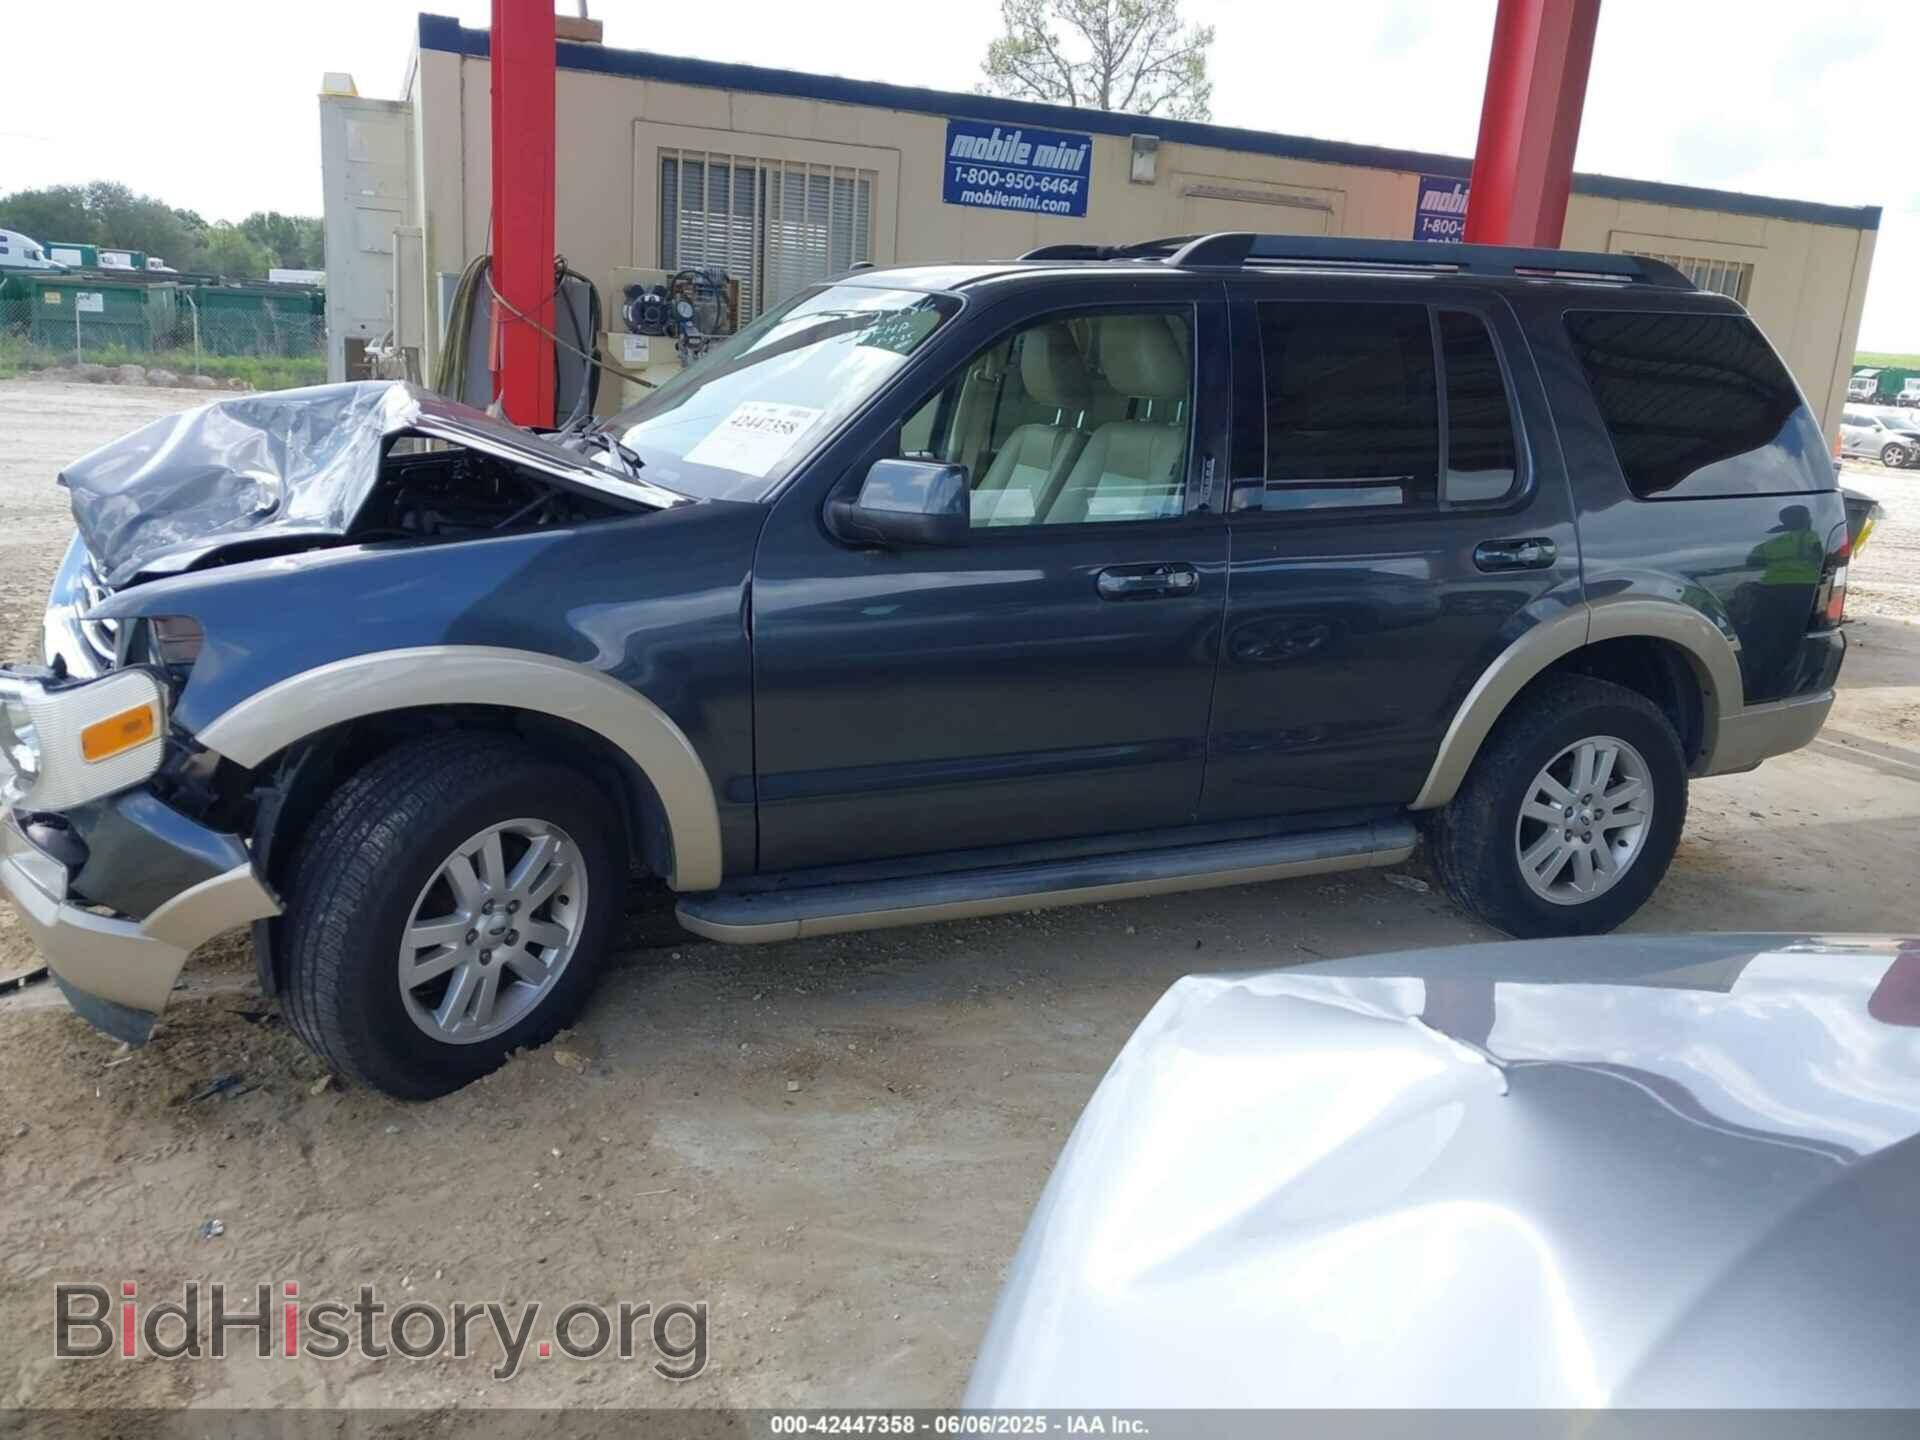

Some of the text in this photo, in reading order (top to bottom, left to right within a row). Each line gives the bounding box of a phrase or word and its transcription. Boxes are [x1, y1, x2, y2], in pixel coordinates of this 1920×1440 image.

[950, 127, 1088, 171] mobile mini
[955, 166, 1079, 195] 1-800-950-6464
[960, 189, 1071, 213] mobilemini.com
[1421, 183, 1471, 214] mobi
